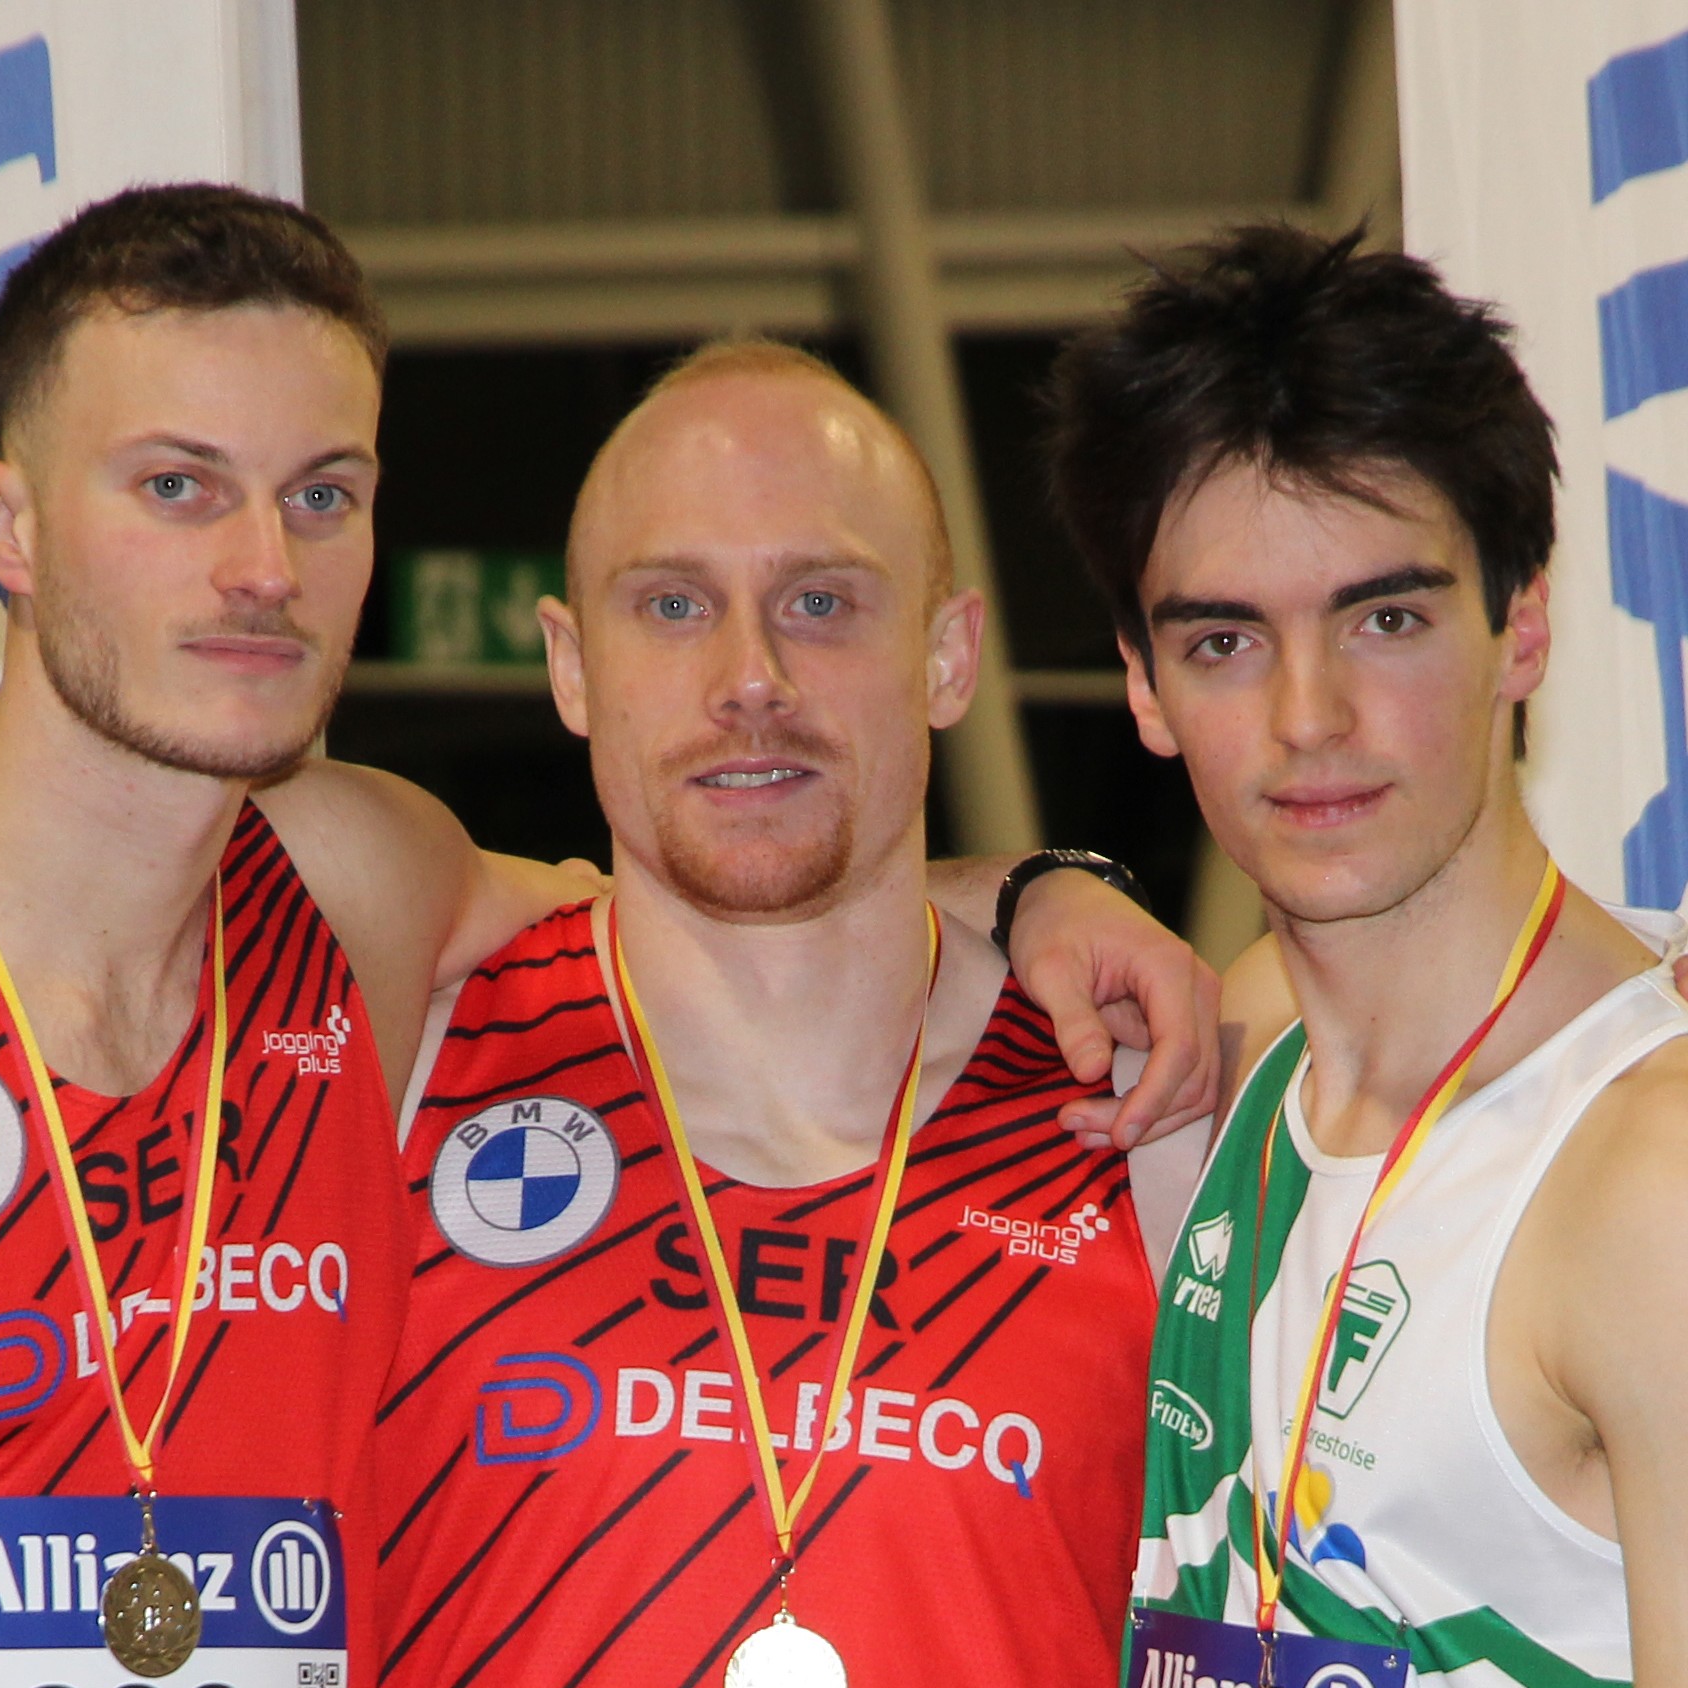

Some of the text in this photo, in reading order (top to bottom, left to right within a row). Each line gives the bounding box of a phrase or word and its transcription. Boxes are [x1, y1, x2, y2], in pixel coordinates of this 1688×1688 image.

[261, 1030, 340, 1056] jogging
[297, 1054, 342, 1076] plus
[458, 1101, 595, 1152] BMW
[957, 1205, 1082, 1248] jogging
[1008, 1238, 1079, 1265] plus
[649, 1222, 900, 1331] SER
